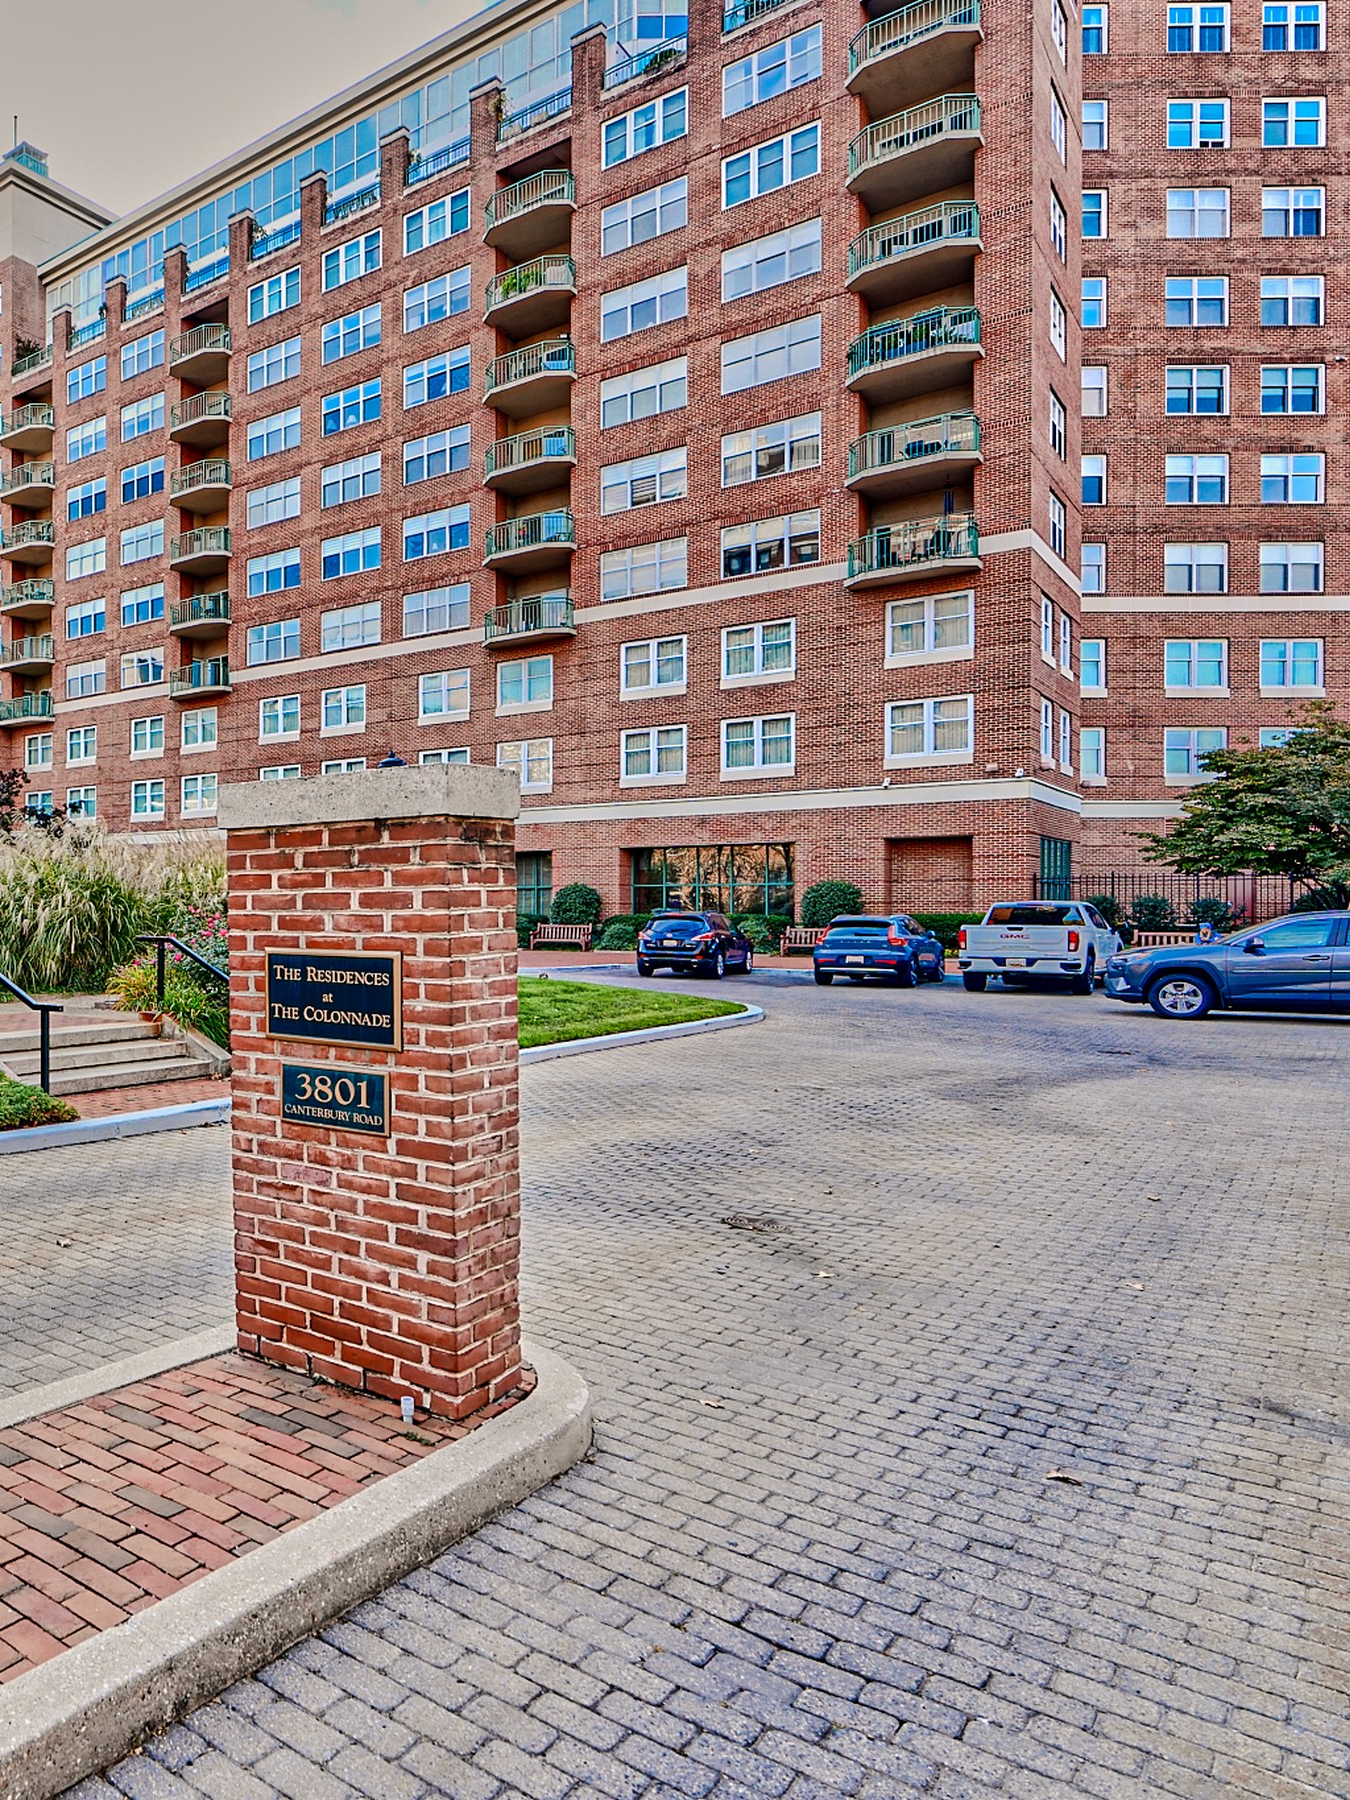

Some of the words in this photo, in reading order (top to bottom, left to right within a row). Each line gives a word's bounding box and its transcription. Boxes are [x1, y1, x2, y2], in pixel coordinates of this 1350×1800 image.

[272, 964, 302, 981] THE
[306, 966, 390, 986] RESIDENCES
[322, 992, 334, 1003] at
[271, 1003, 300, 1020] THE
[303, 1005, 391, 1028] COLONNADE
[294, 1072, 371, 1109] 3801
[284, 1103, 351, 1122] CANTERBURY
[352, 1112, 383, 1127] ROAD
